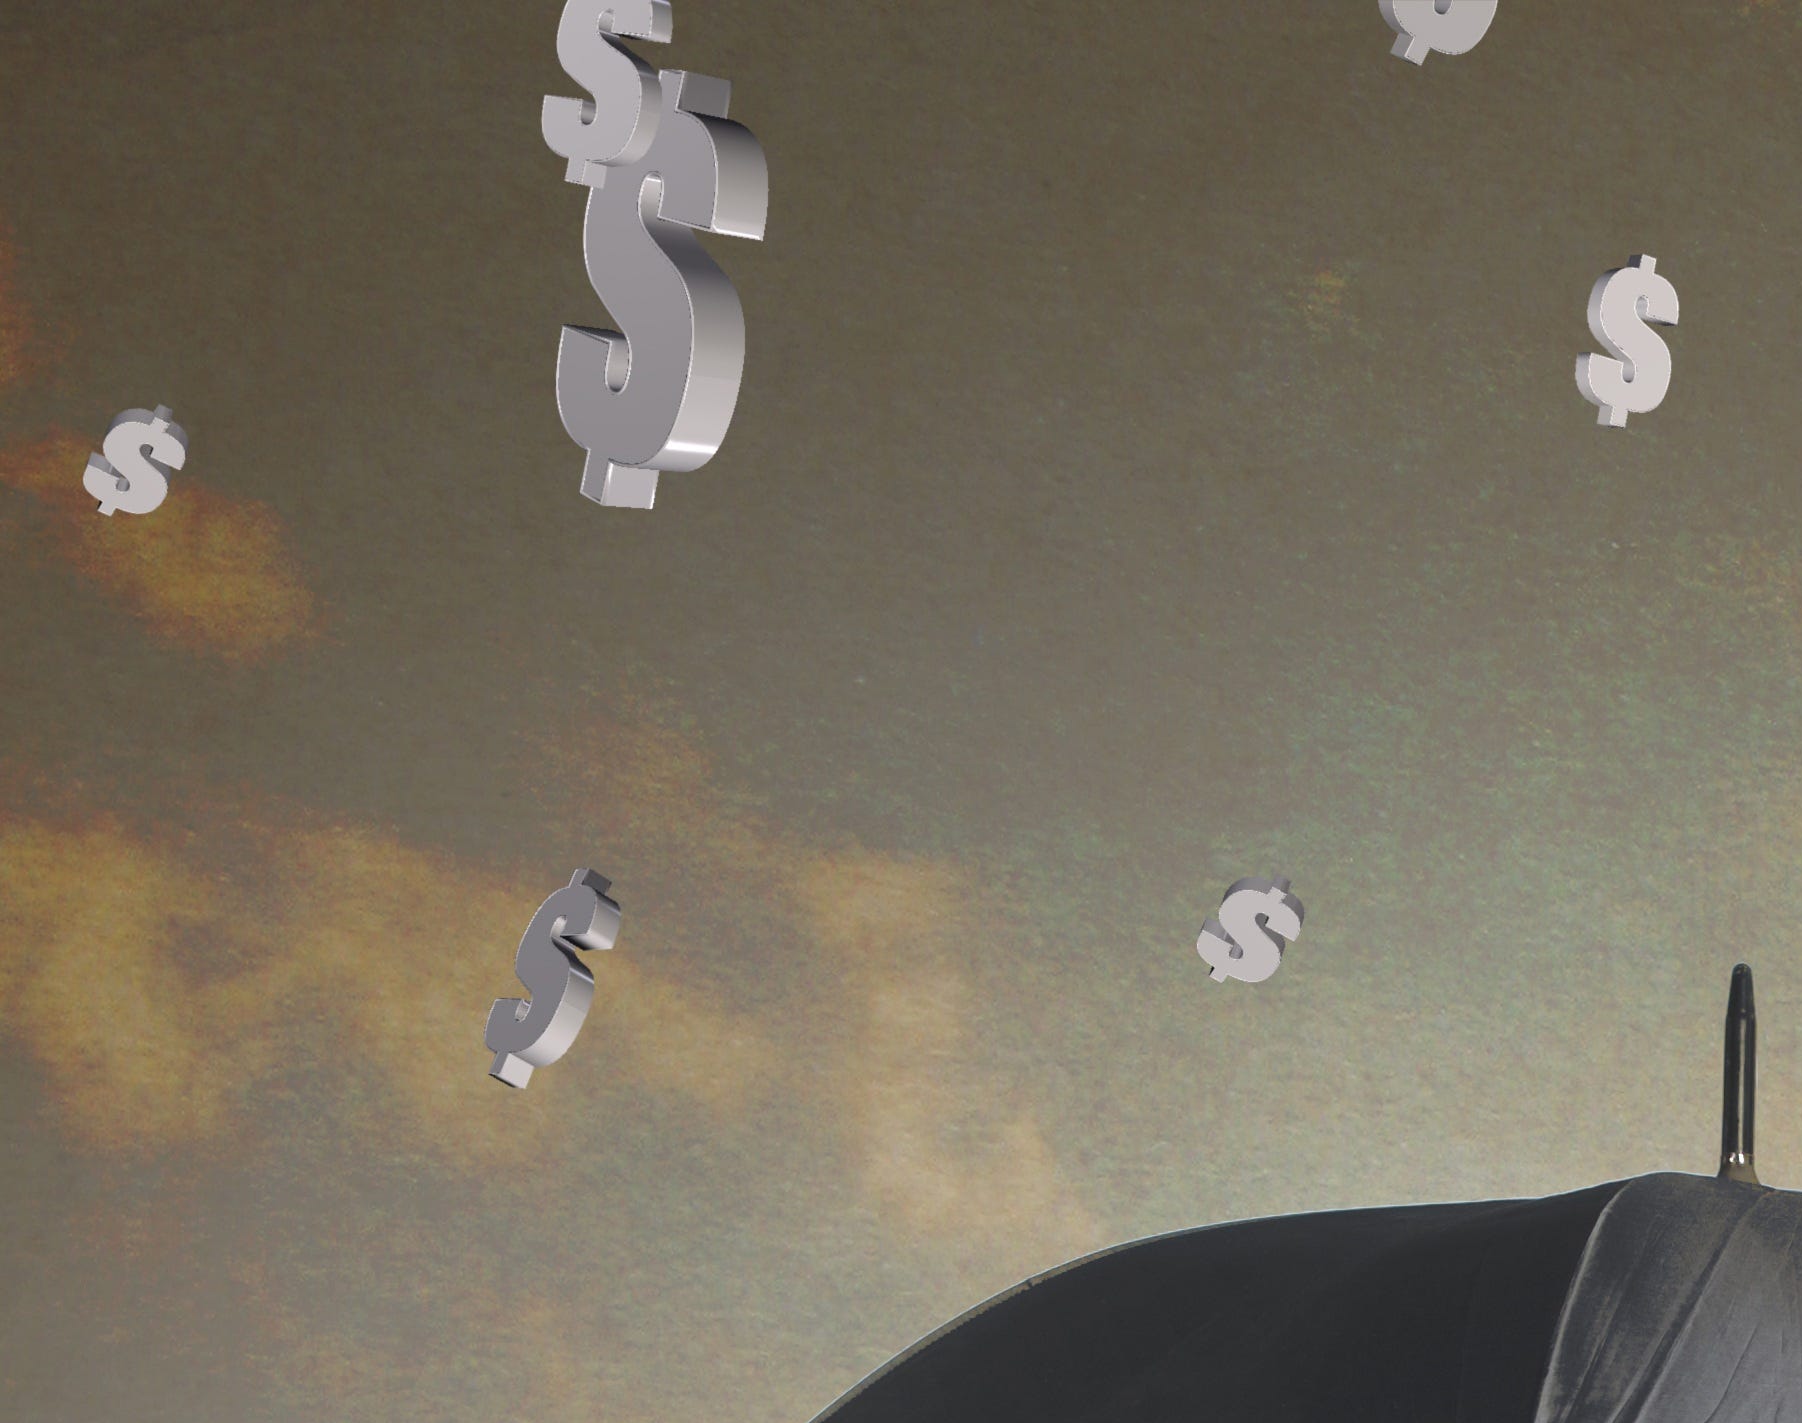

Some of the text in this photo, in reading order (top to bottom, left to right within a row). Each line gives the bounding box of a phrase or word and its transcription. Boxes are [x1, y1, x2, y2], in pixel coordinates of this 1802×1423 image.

[542, 0, 672, 187] $
[557, 70, 768, 509] $
[1576, 254, 1679, 428] $
[82, 405, 188, 516] $
[485, 868, 621, 1089] $
[1197, 877, 1304, 983] $
